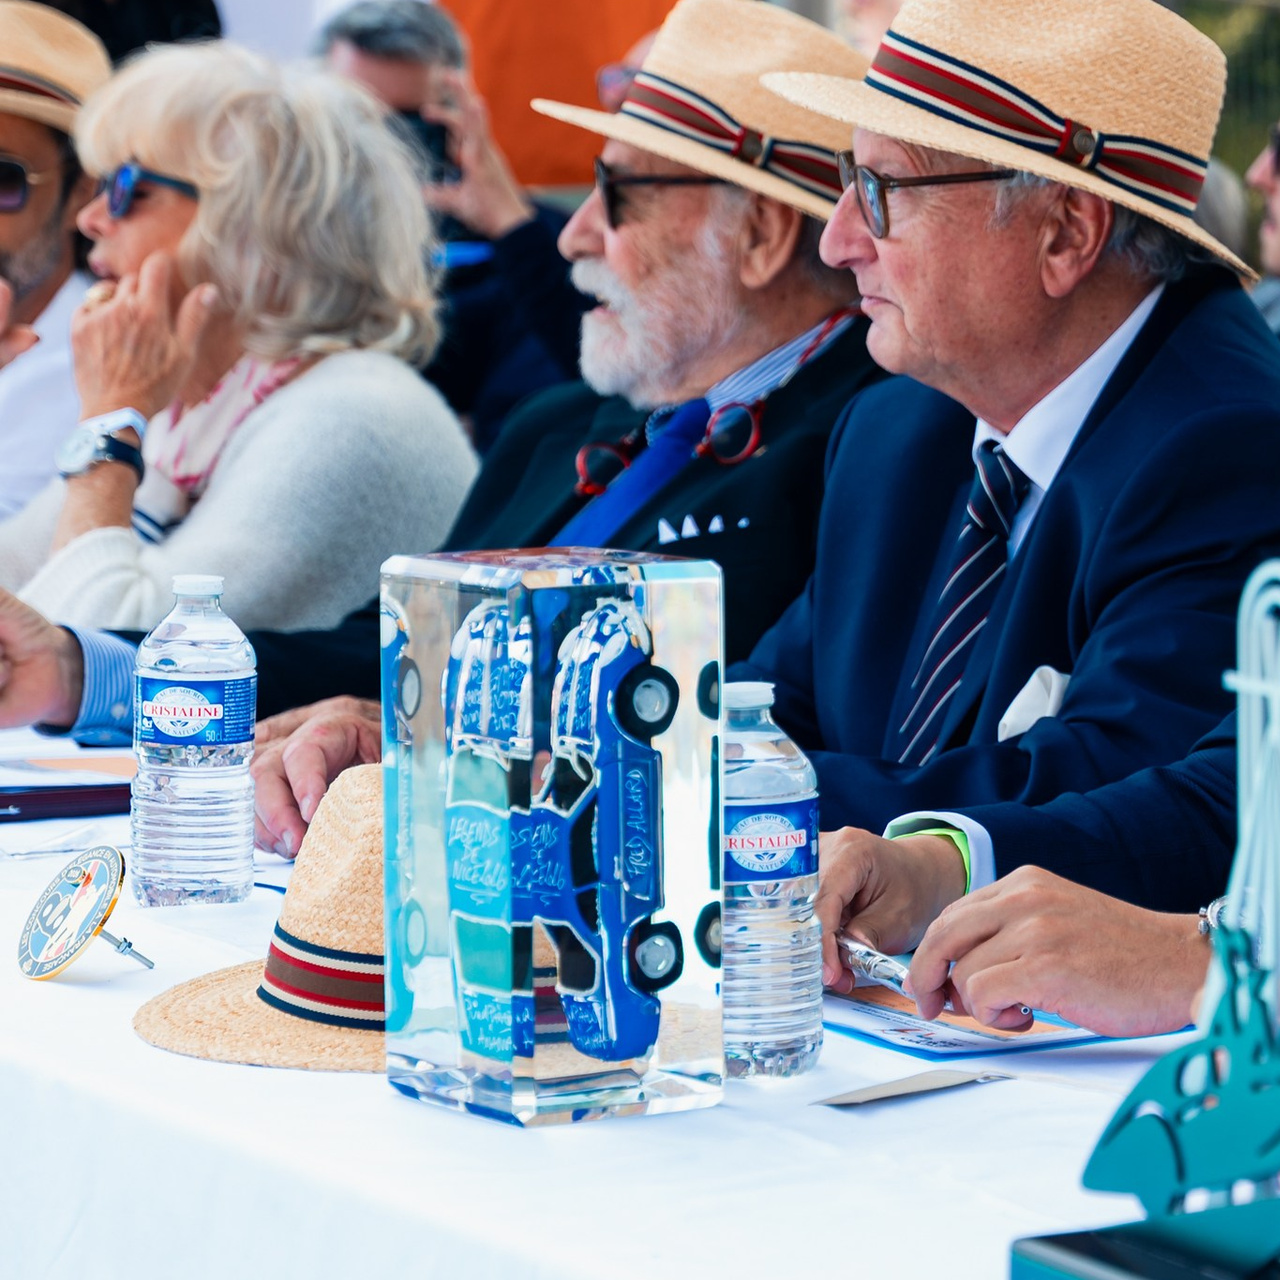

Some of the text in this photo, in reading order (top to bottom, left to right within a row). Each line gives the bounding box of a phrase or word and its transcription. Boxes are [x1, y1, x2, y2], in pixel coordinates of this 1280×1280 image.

[143, 704, 220, 718] CRISTALINE
[624, 768, 648, 834] ALLARD
[461, 842, 482, 865] DE
